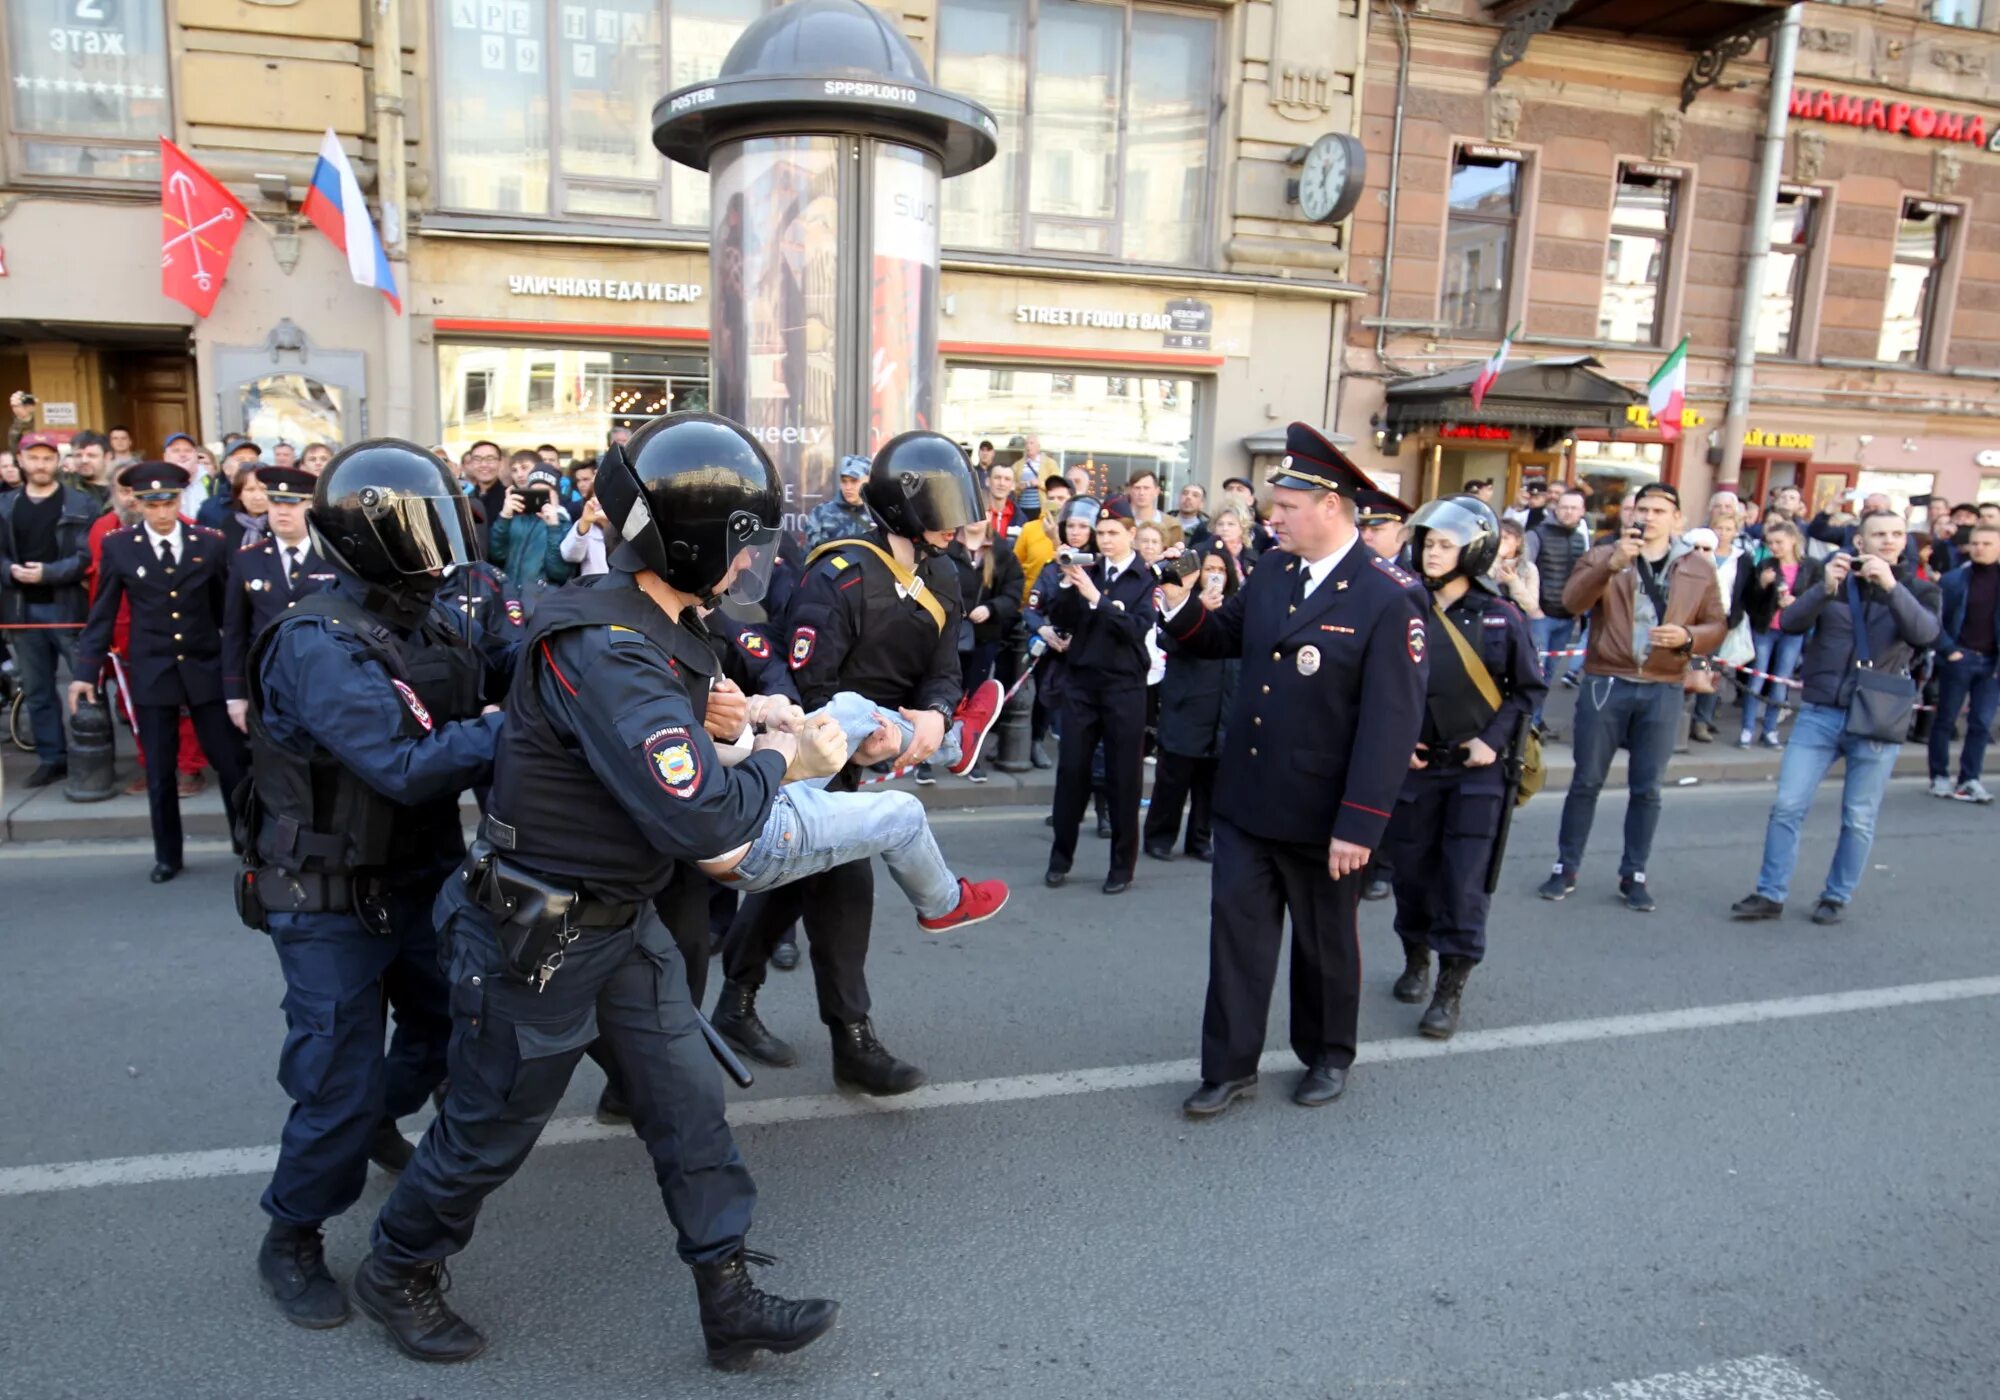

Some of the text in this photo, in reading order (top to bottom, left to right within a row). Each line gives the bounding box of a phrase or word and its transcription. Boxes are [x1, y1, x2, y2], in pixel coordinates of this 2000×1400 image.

[50, 28, 125, 55] этаж
[508, 274, 703, 302] УЛИЧНАЯ ЕДА И БАР
[1016, 305, 1173, 331] STREET FOOD & BAR
[645, 726, 686, 747] ПОЛИЦИЯ
